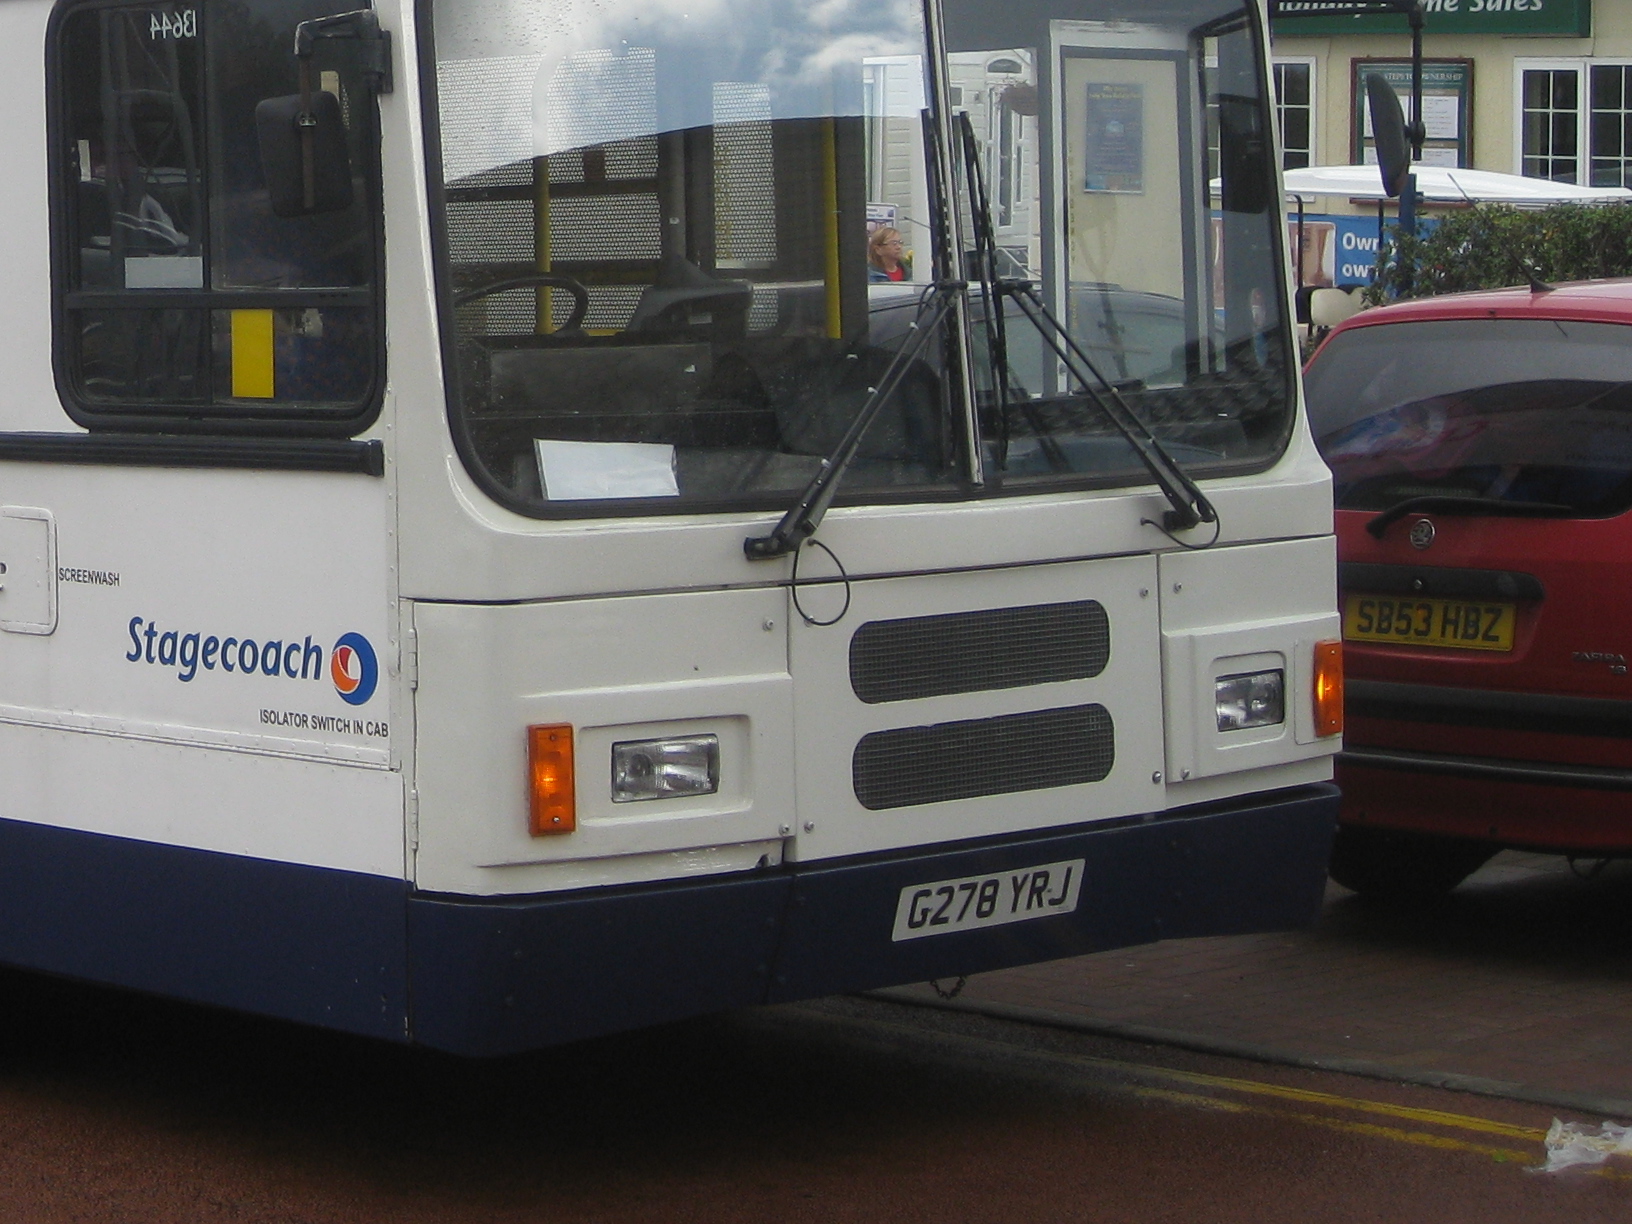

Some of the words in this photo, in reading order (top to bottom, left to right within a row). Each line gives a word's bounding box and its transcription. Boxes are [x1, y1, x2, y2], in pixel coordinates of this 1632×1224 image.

[58, 567, 121, 587] SCREENWASH
[1356, 599, 1433, 638] SB53
[1440, 605, 1503, 643] HBZ
[126, 615, 323, 683] Stagecoach
[260, 709, 309, 729] ISOLATOR
[311, 715, 352, 735] SWITCH
[353, 720, 364, 735] IN
[366, 722, 389, 738] CAB
[907, 878, 1000, 929] G278
[1010, 865, 1073, 914] YRJ
